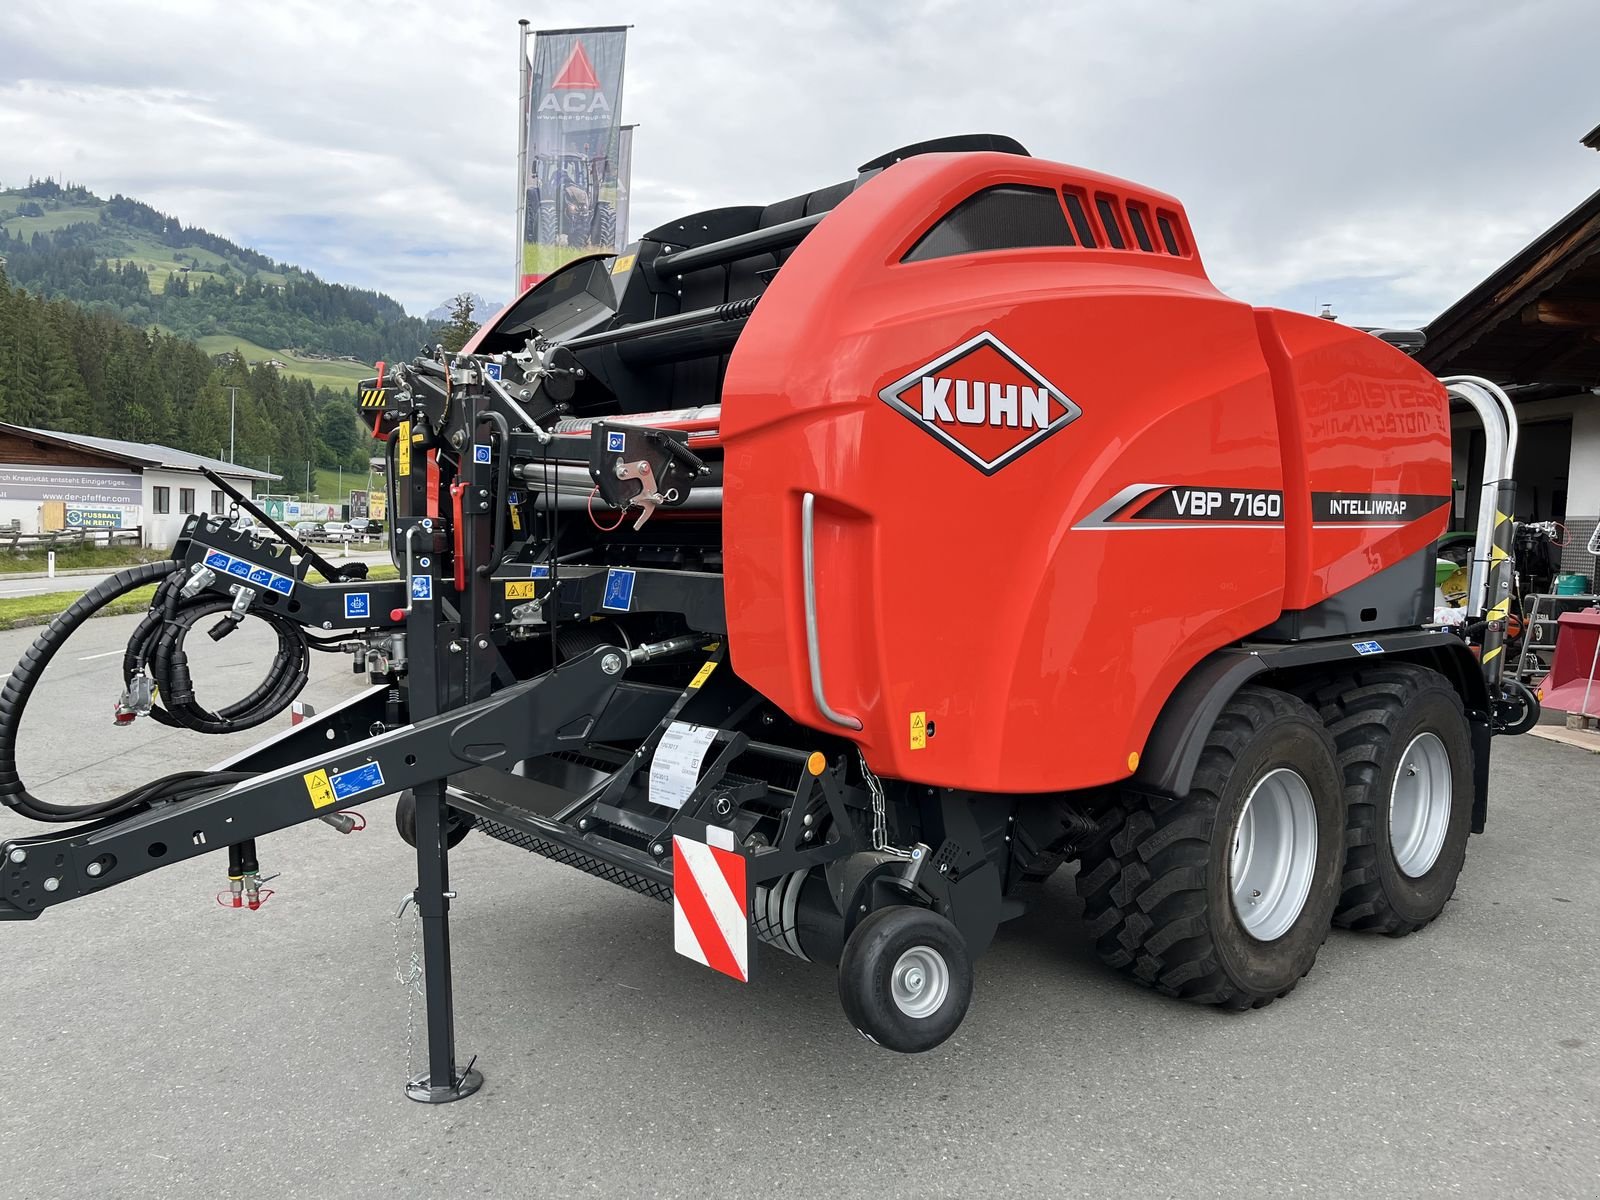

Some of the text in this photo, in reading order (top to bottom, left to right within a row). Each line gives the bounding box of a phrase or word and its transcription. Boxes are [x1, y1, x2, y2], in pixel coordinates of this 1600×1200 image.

[537, 92, 610, 113] ACA
[922, 376, 1049, 429] KUHN
[42, 493, 130, 503] www.der-pfeffer.com
[1171, 490, 1282, 517] VBP 7160
[1329, 499, 1407, 515] INTELLIWRAP
[83, 512, 121, 520] FUSSBALL
